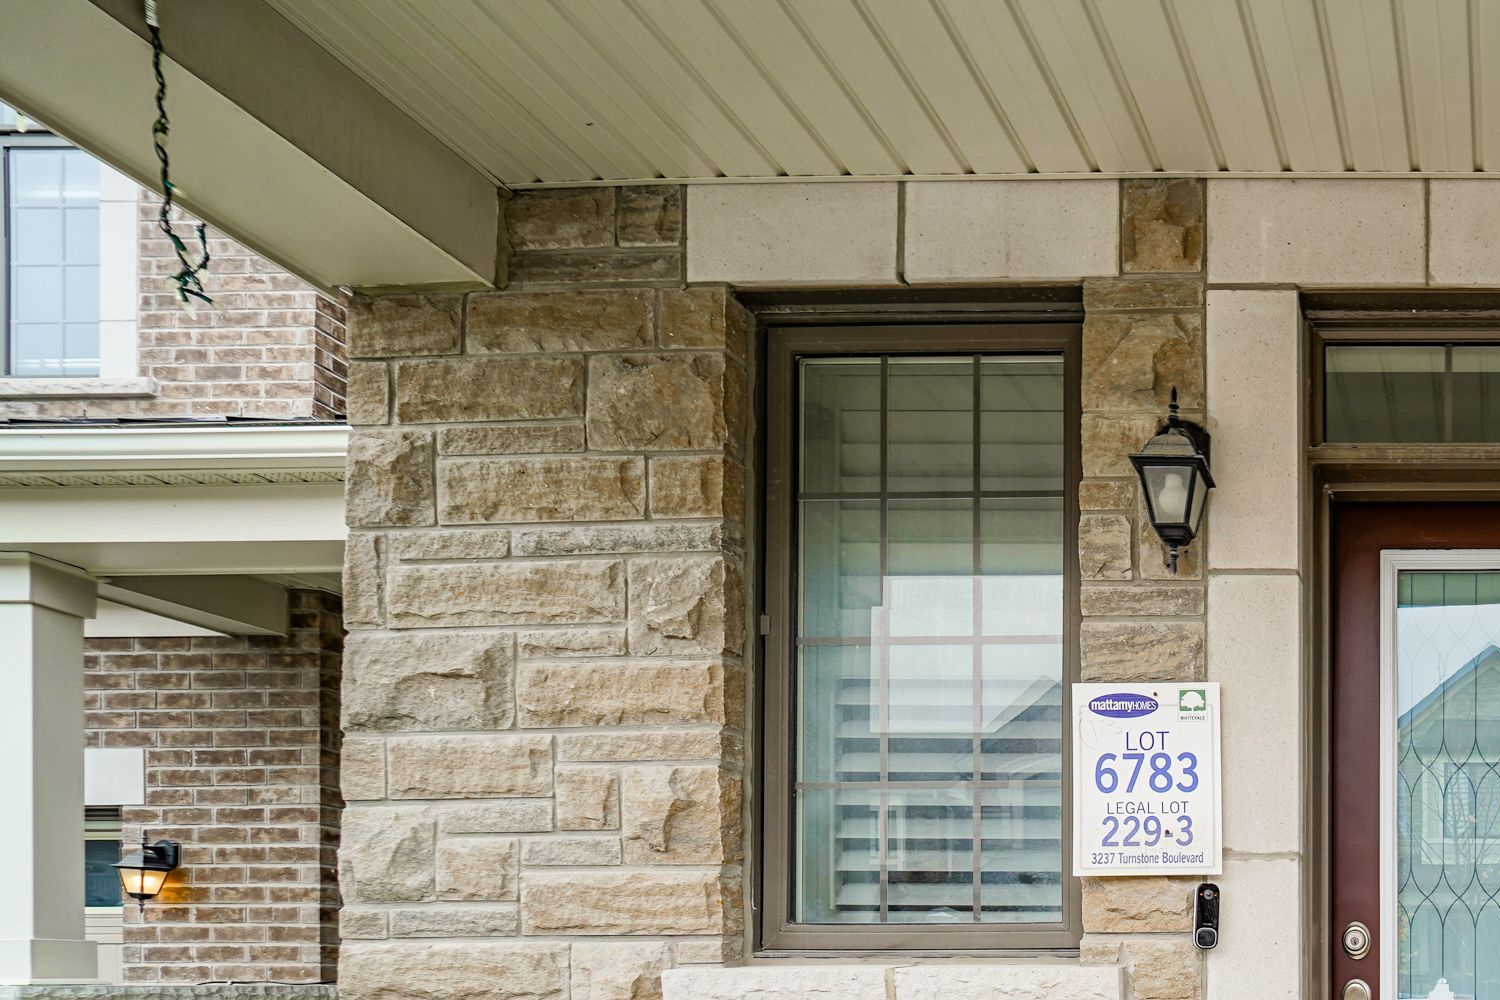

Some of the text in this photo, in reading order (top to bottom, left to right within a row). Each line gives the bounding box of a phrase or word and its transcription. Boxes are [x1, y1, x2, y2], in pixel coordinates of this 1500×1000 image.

[1126, 731, 1170, 751] LOT
[1095, 752, 1199, 794] 6783
[1107, 801, 1189, 815] LEGAL LOT
[1091, 851, 1204, 865] 3237 Turnstone Boulevard
